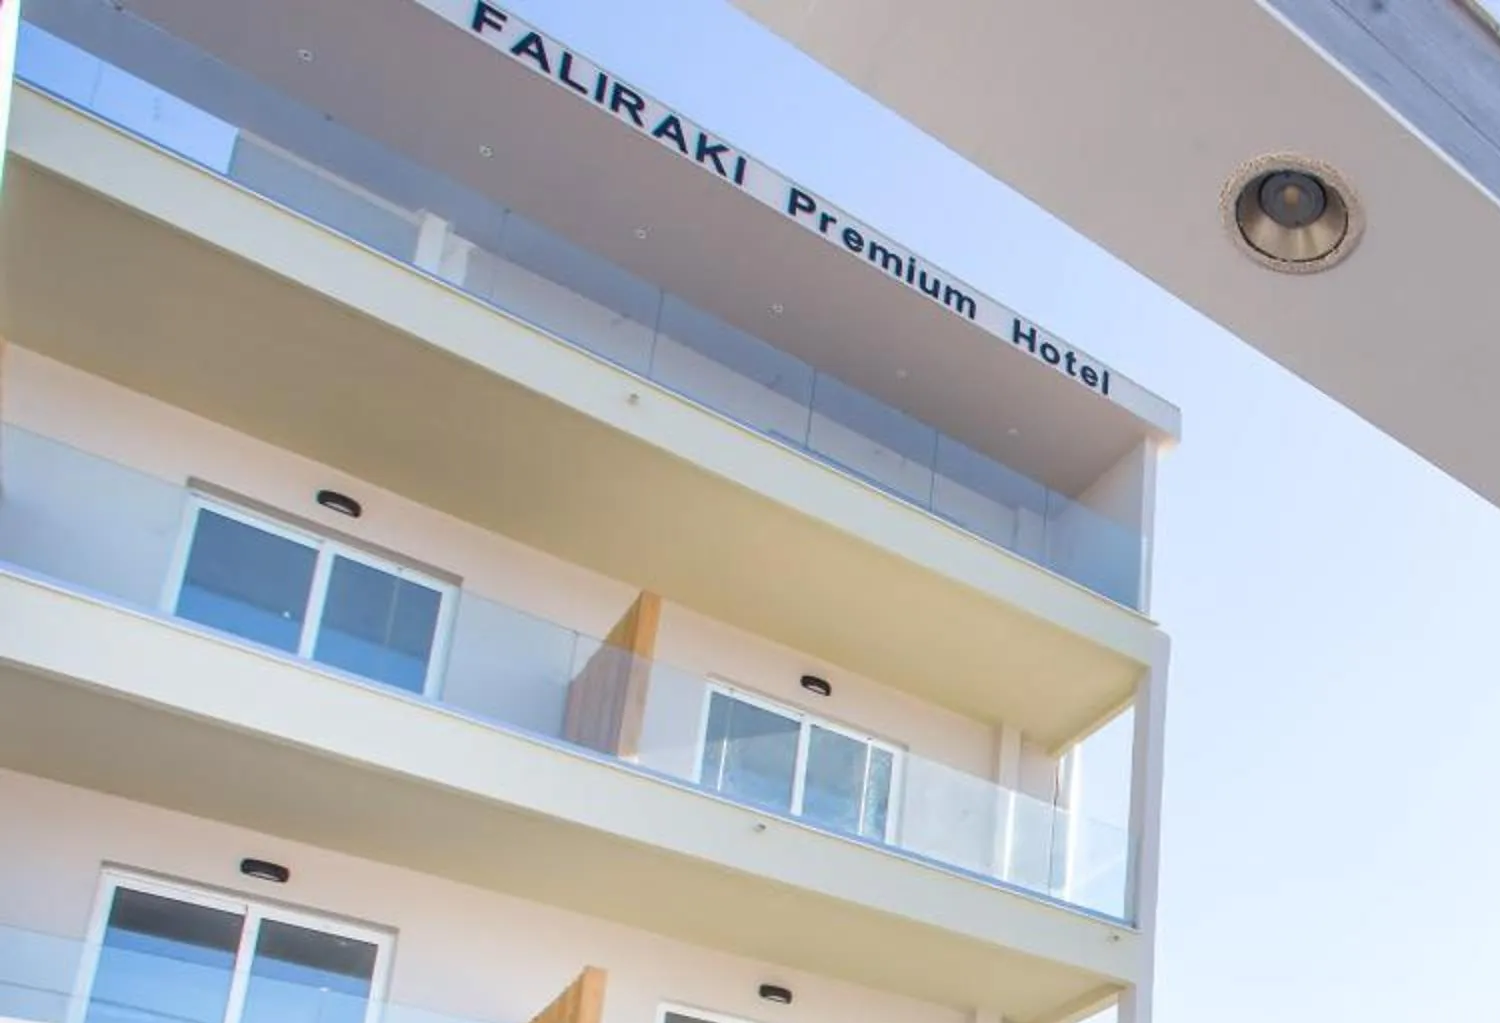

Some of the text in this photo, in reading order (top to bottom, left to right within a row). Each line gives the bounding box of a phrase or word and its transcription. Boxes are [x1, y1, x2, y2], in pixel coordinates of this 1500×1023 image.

[472, 0, 1109, 395] FALIRAKI Premium Hotel
